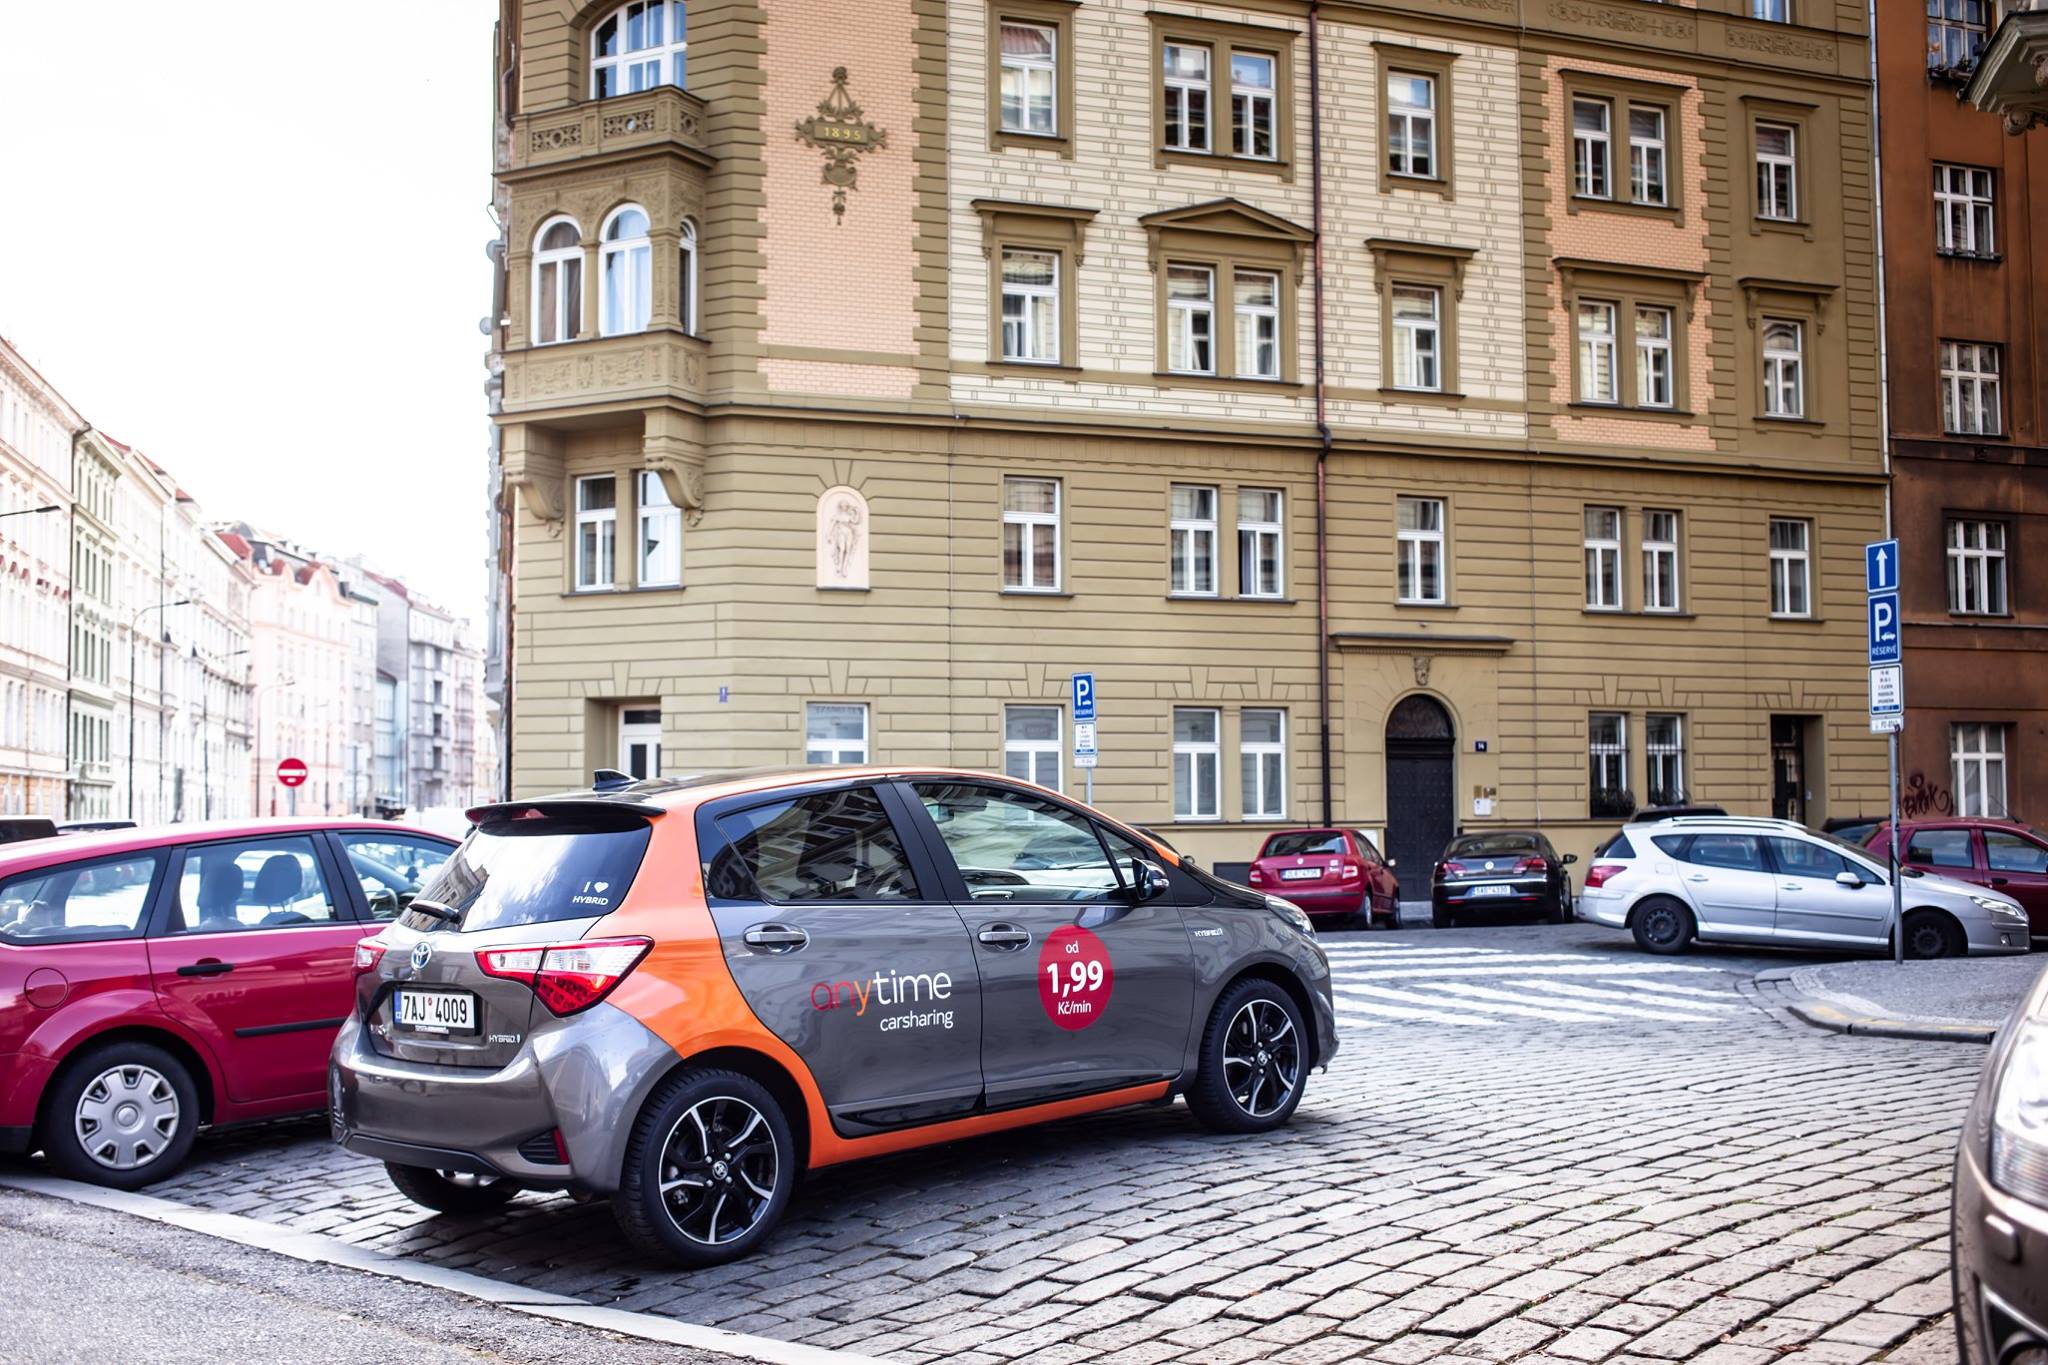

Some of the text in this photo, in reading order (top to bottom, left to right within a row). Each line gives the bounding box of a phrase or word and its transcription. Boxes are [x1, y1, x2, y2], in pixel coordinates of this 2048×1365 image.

[824, 127, 861, 140] 1895
[1874, 602, 1892, 642] P
[1076, 679, 1090, 706] P
[583, 881, 591, 893] I
[572, 895, 609, 906] HYBRID
[1065, 940, 1080, 954] od
[1046, 960, 1104, 998] 1,99
[810, 969, 952, 1017] anytime
[403, 995, 467, 1024] 7AJ 4009
[1057, 1000, 1092, 1015] Kč/min
[880, 1009, 954, 1032] carsharing
[488, 1034, 516, 1044] HYBRID
